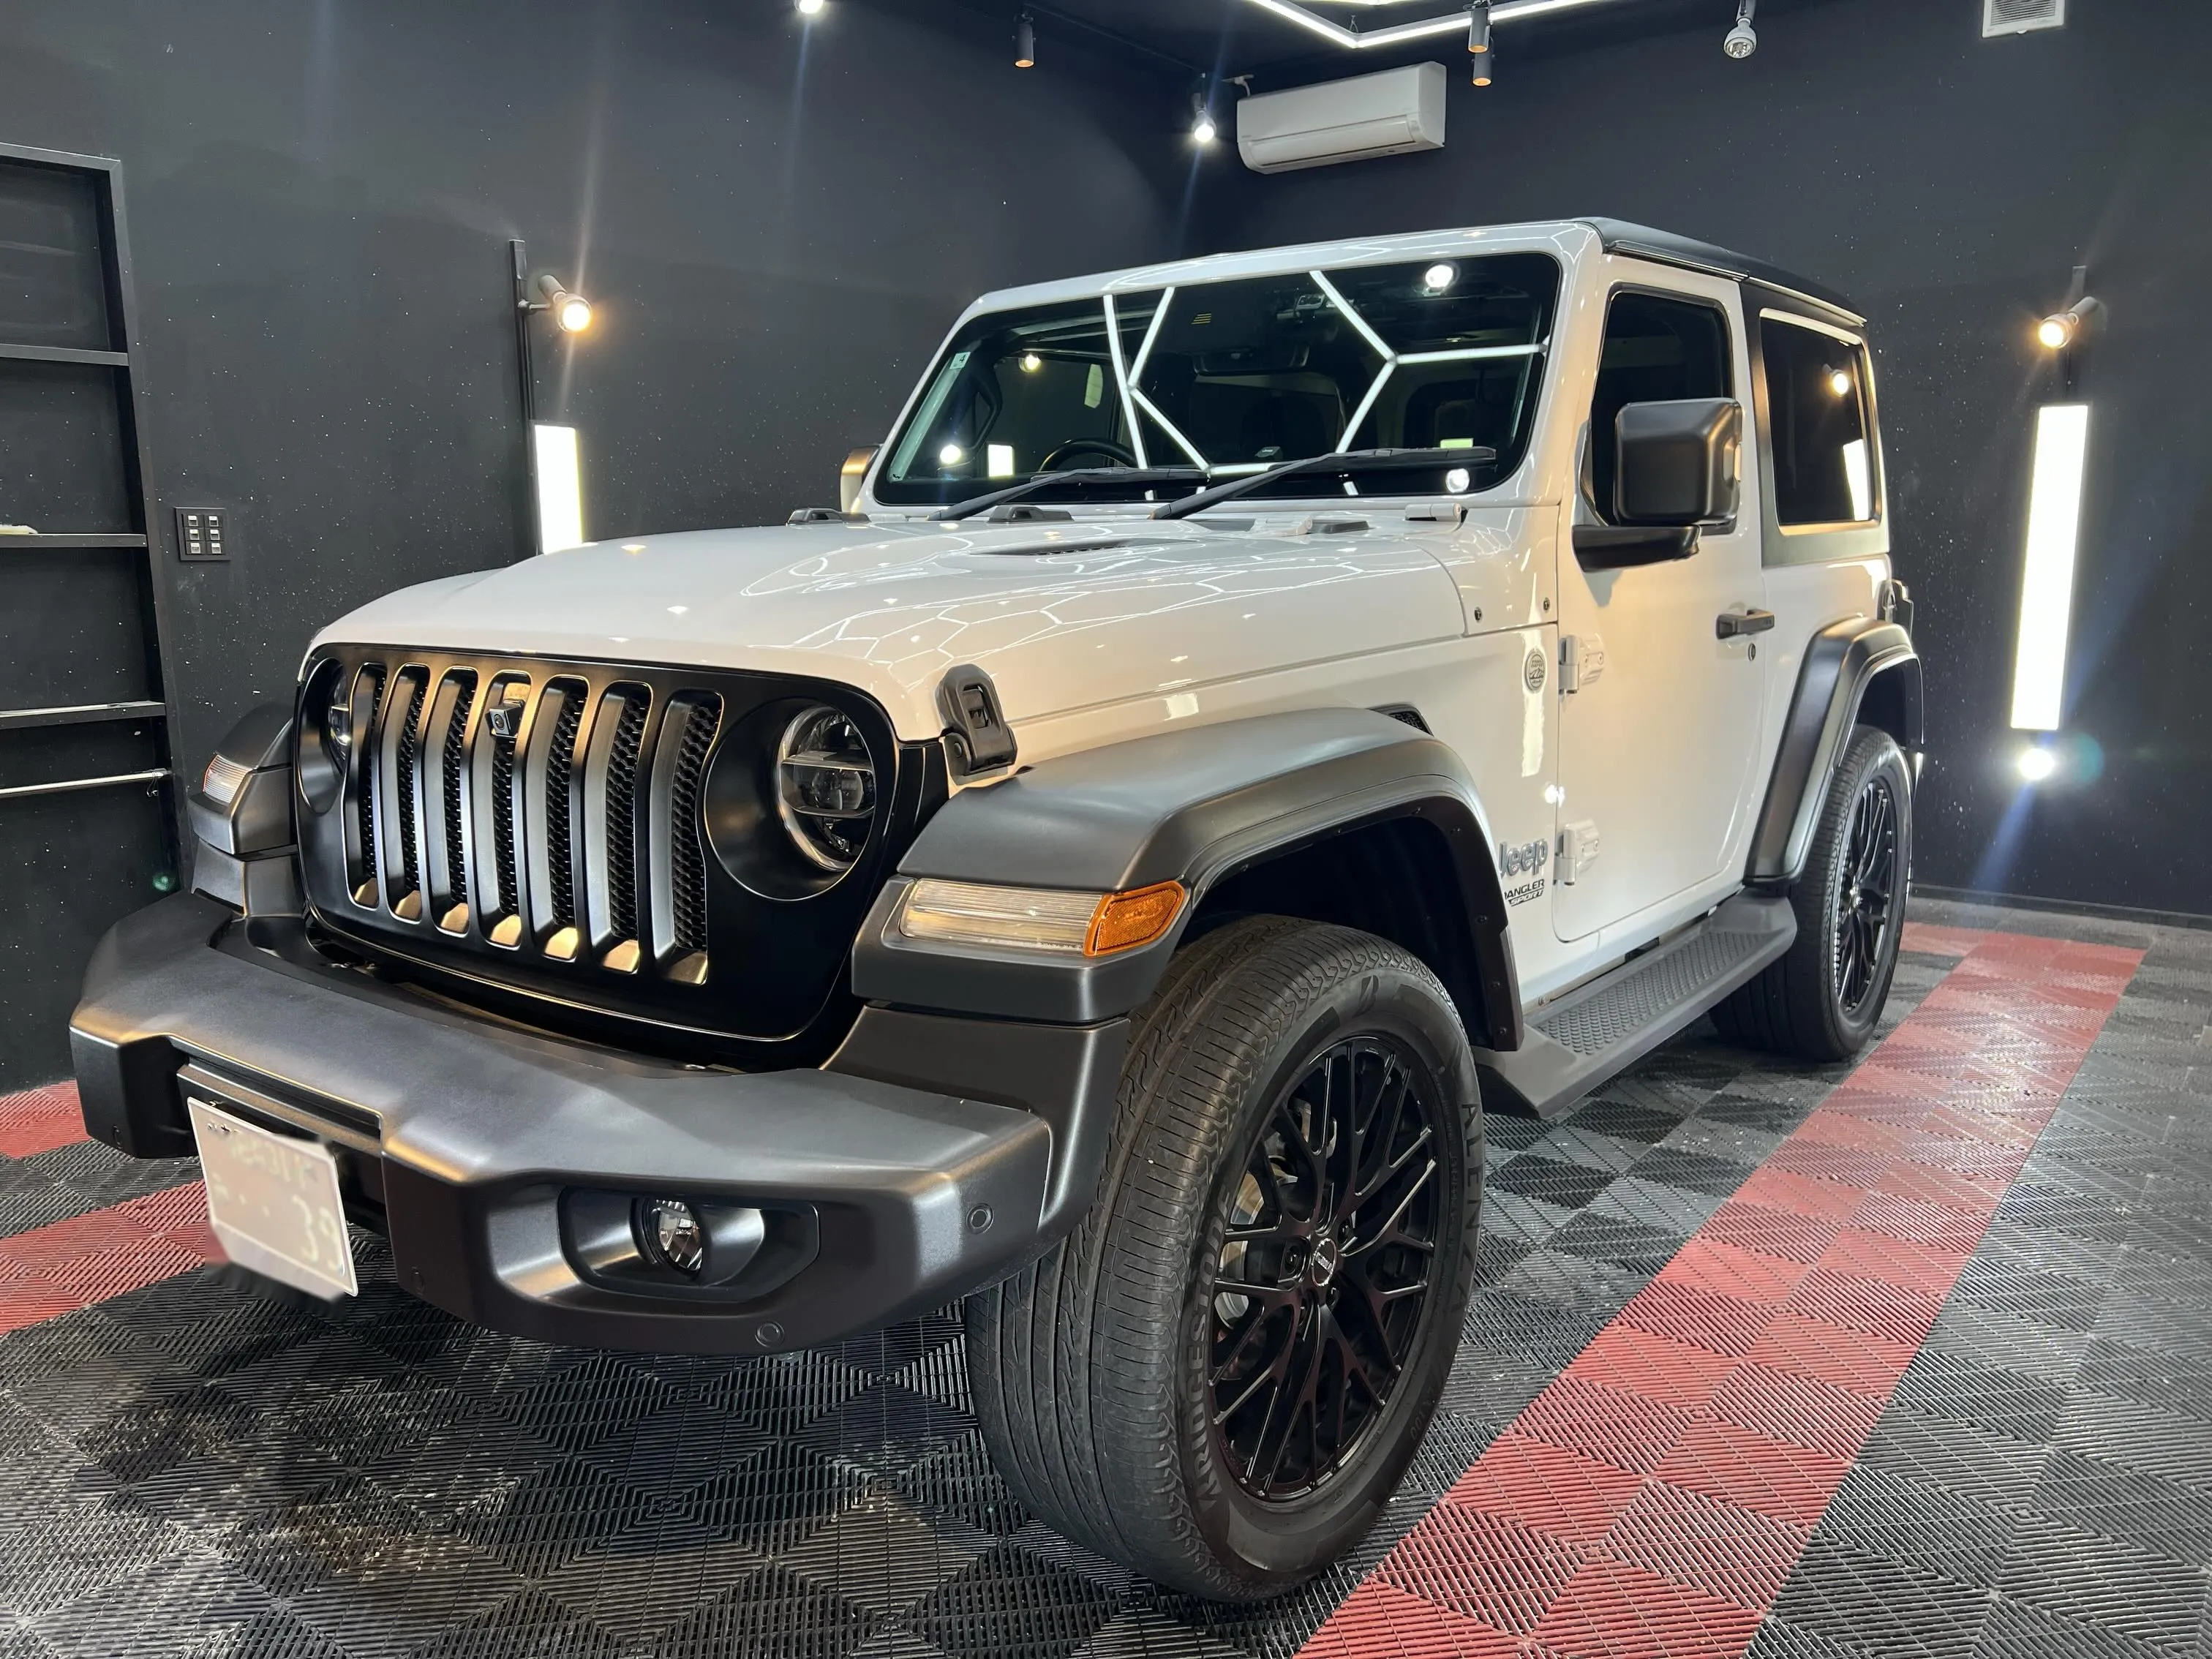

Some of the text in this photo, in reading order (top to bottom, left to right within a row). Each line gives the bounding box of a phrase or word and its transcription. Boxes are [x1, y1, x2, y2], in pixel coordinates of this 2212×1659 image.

[1499, 838, 1548, 879] Jeep
[1504, 879, 1544, 900] ANGLER
[1509, 890, 1543, 906] SPORT
